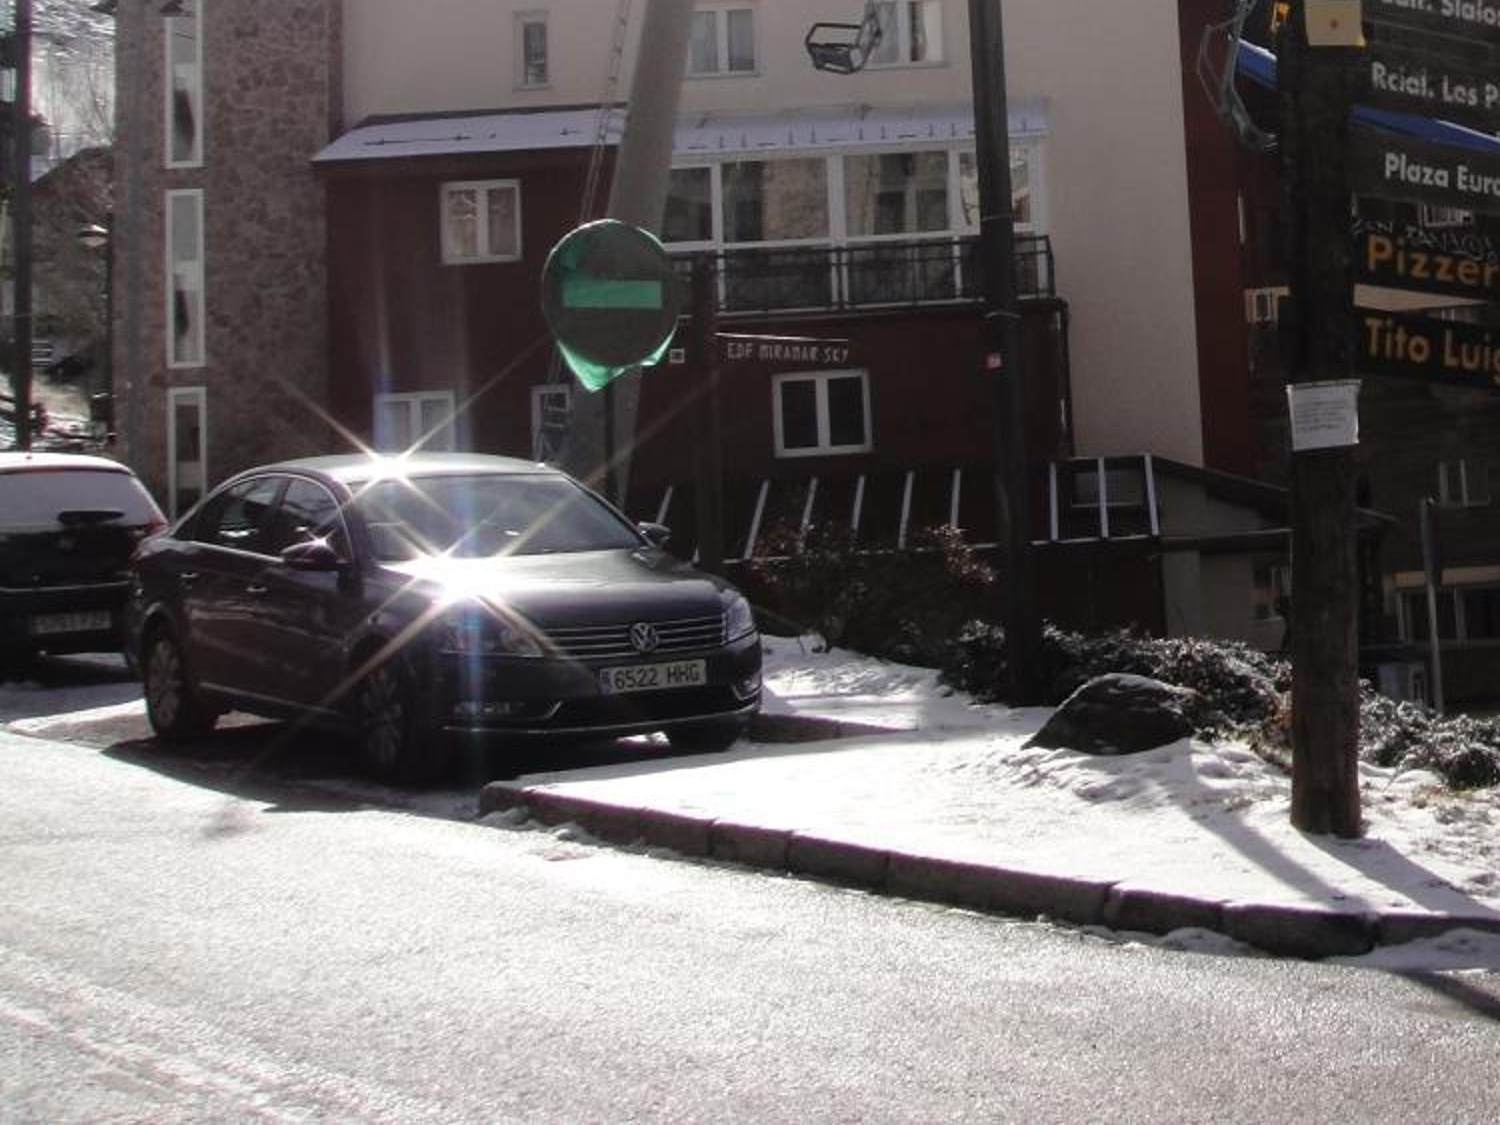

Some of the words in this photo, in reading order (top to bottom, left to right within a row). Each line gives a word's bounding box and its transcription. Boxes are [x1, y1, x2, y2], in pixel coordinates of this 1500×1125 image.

[1385, 152, 1449, 188] Plaza
[1362, 316, 1432, 363] Tito
[614, 668, 658, 689] 6522
